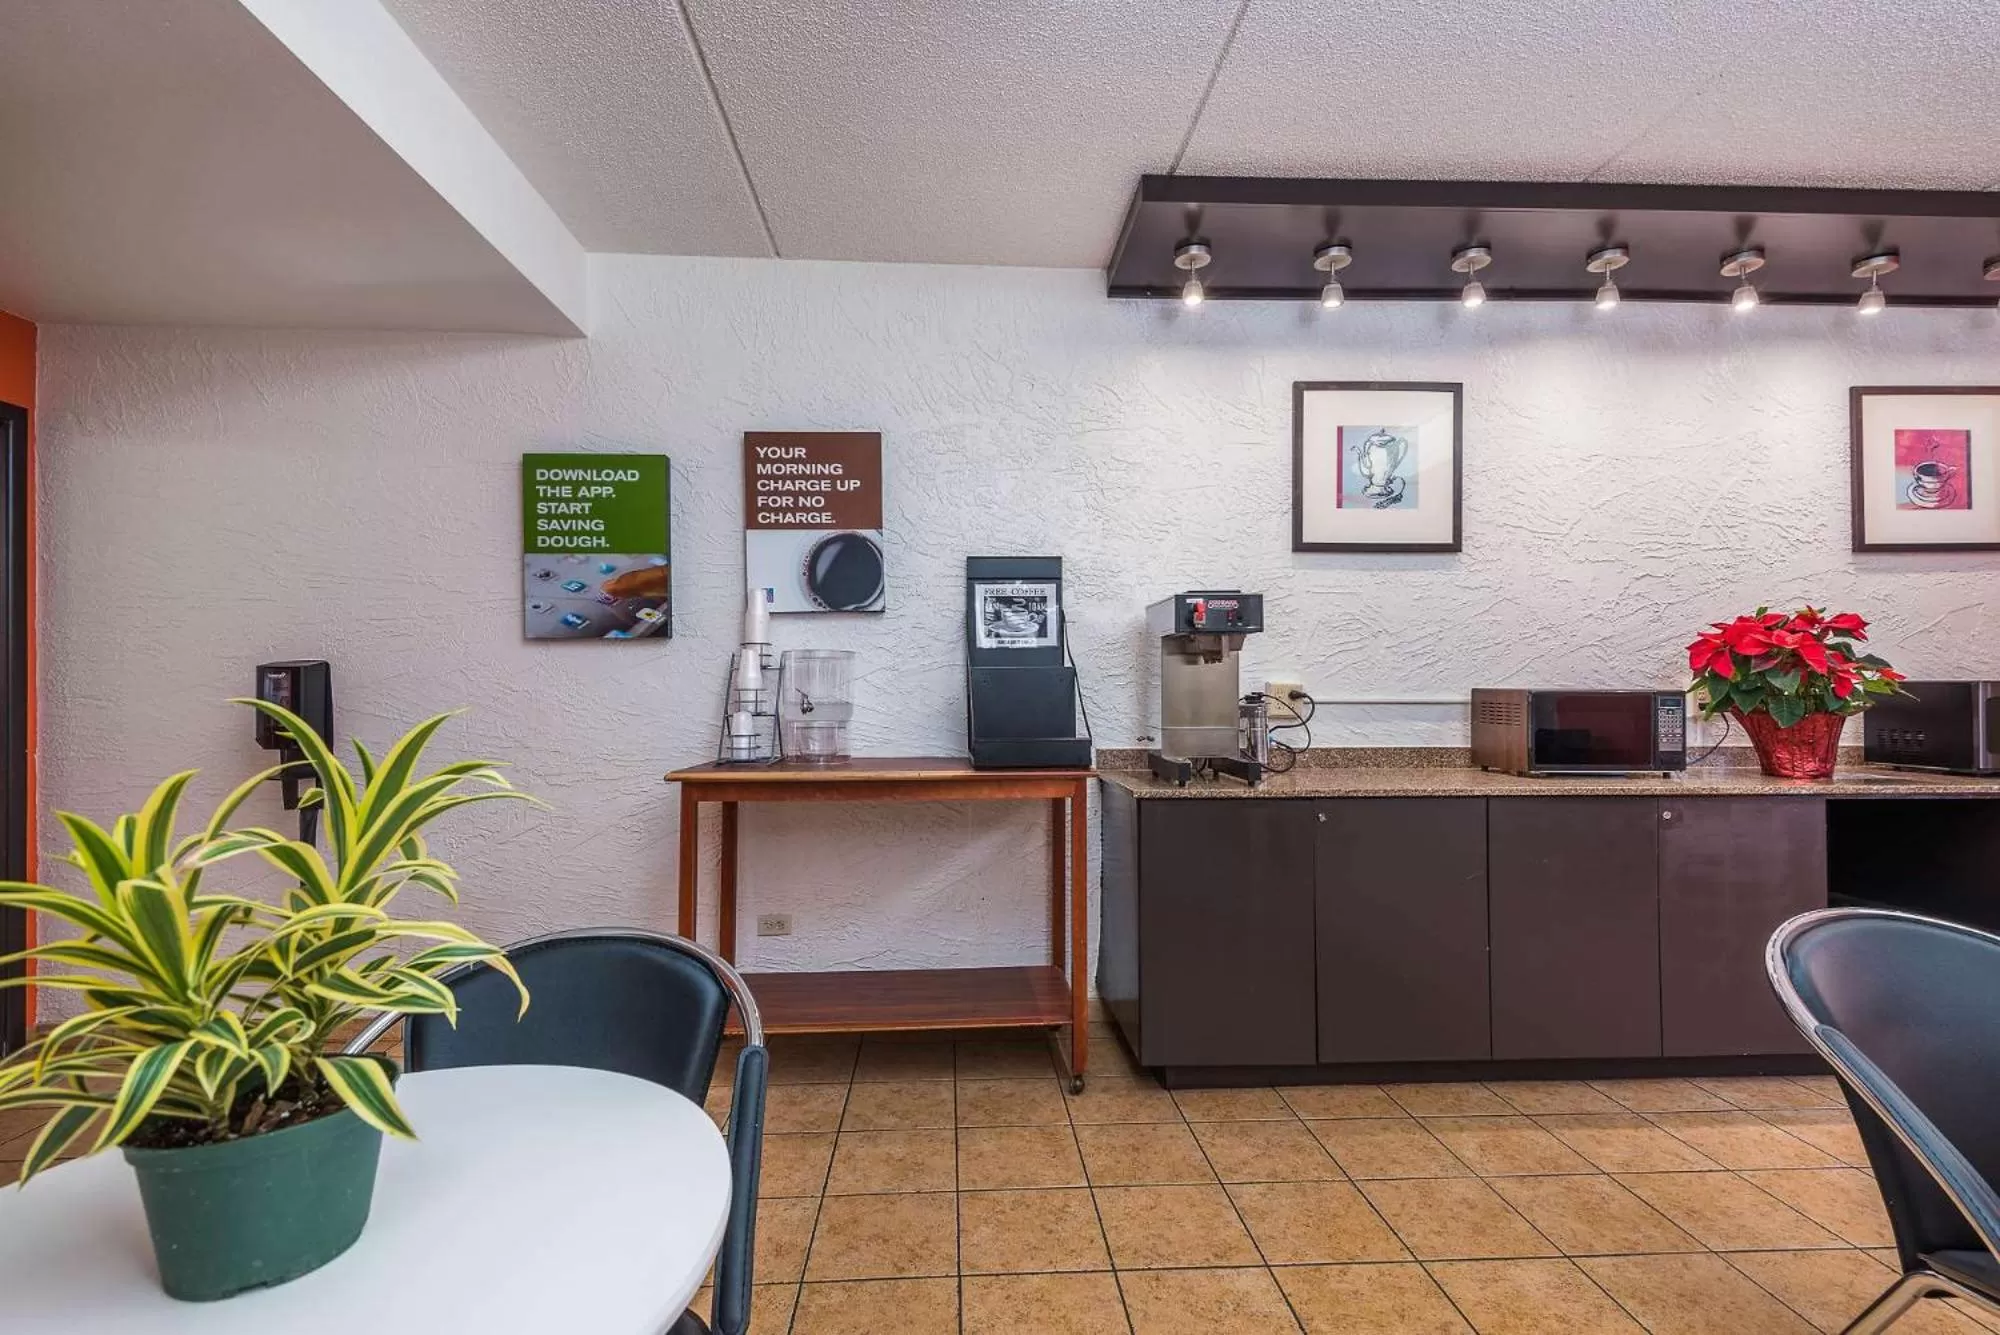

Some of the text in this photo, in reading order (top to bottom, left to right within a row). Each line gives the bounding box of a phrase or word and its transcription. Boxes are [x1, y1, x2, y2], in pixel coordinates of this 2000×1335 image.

[755, 446, 806, 459] YOUR
[535, 468, 640, 482] DOWNLOAD
[756, 463, 843, 475] MORNING
[535, 485, 616, 498] THE APP.
[756, 479, 861, 491] CHARGE UP
[536, 502, 592, 514] START
[757, 495, 825, 508] FOR NO
[757, 511, 836, 524] CHARGE.
[536, 518, 605, 531] SAVING
[536, 535, 610, 548] DOUGH.
[984, 587, 1047, 596] FREE COFFEE
